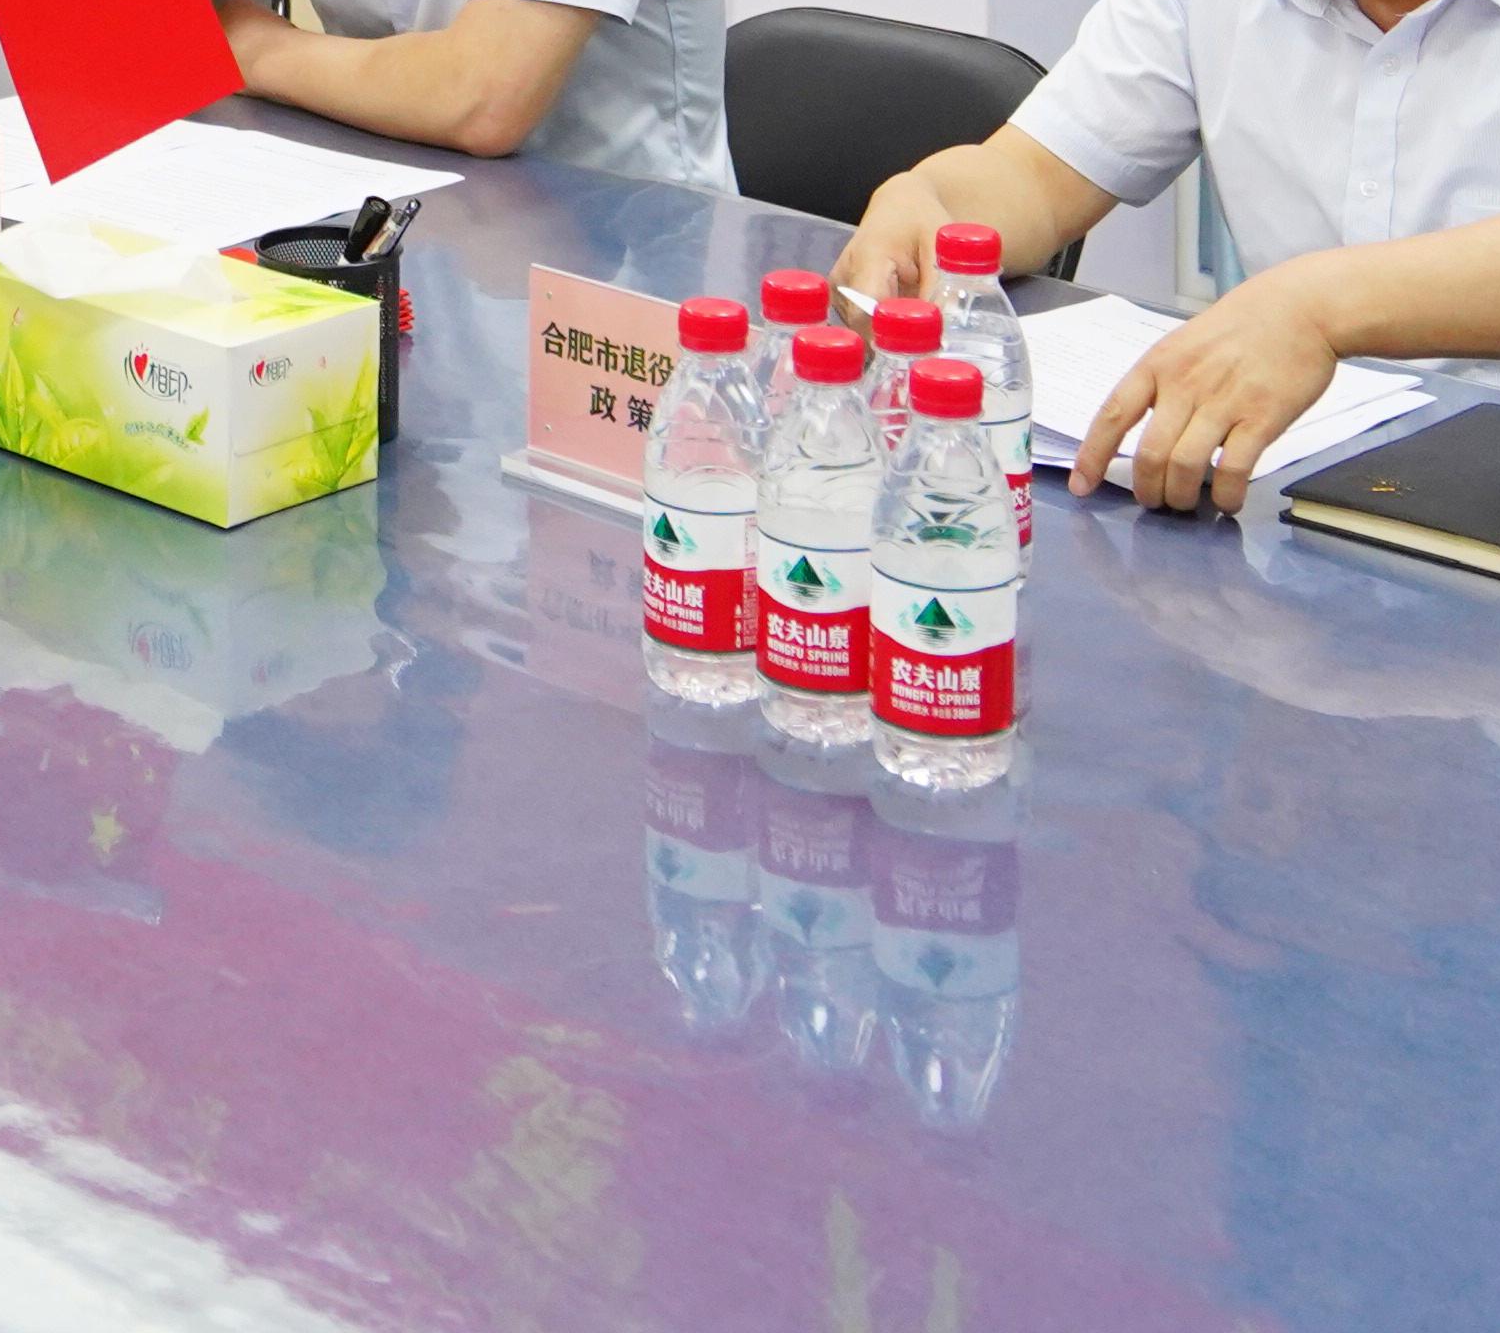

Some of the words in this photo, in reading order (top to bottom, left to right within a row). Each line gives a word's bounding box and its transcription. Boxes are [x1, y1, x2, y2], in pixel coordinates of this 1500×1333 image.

[541, 321, 675, 387] 合肥市退役
[589, 384, 655, 432] 政策
[767, 613, 850, 650] 农夫山泉
[767, 636, 805, 660] NONGFU
[807, 648, 850, 664] SPRING
[890, 657, 980, 692] 农夫山泉
[890, 681, 935, 703] NONGFU
[938, 693, 981, 706] SPRING
